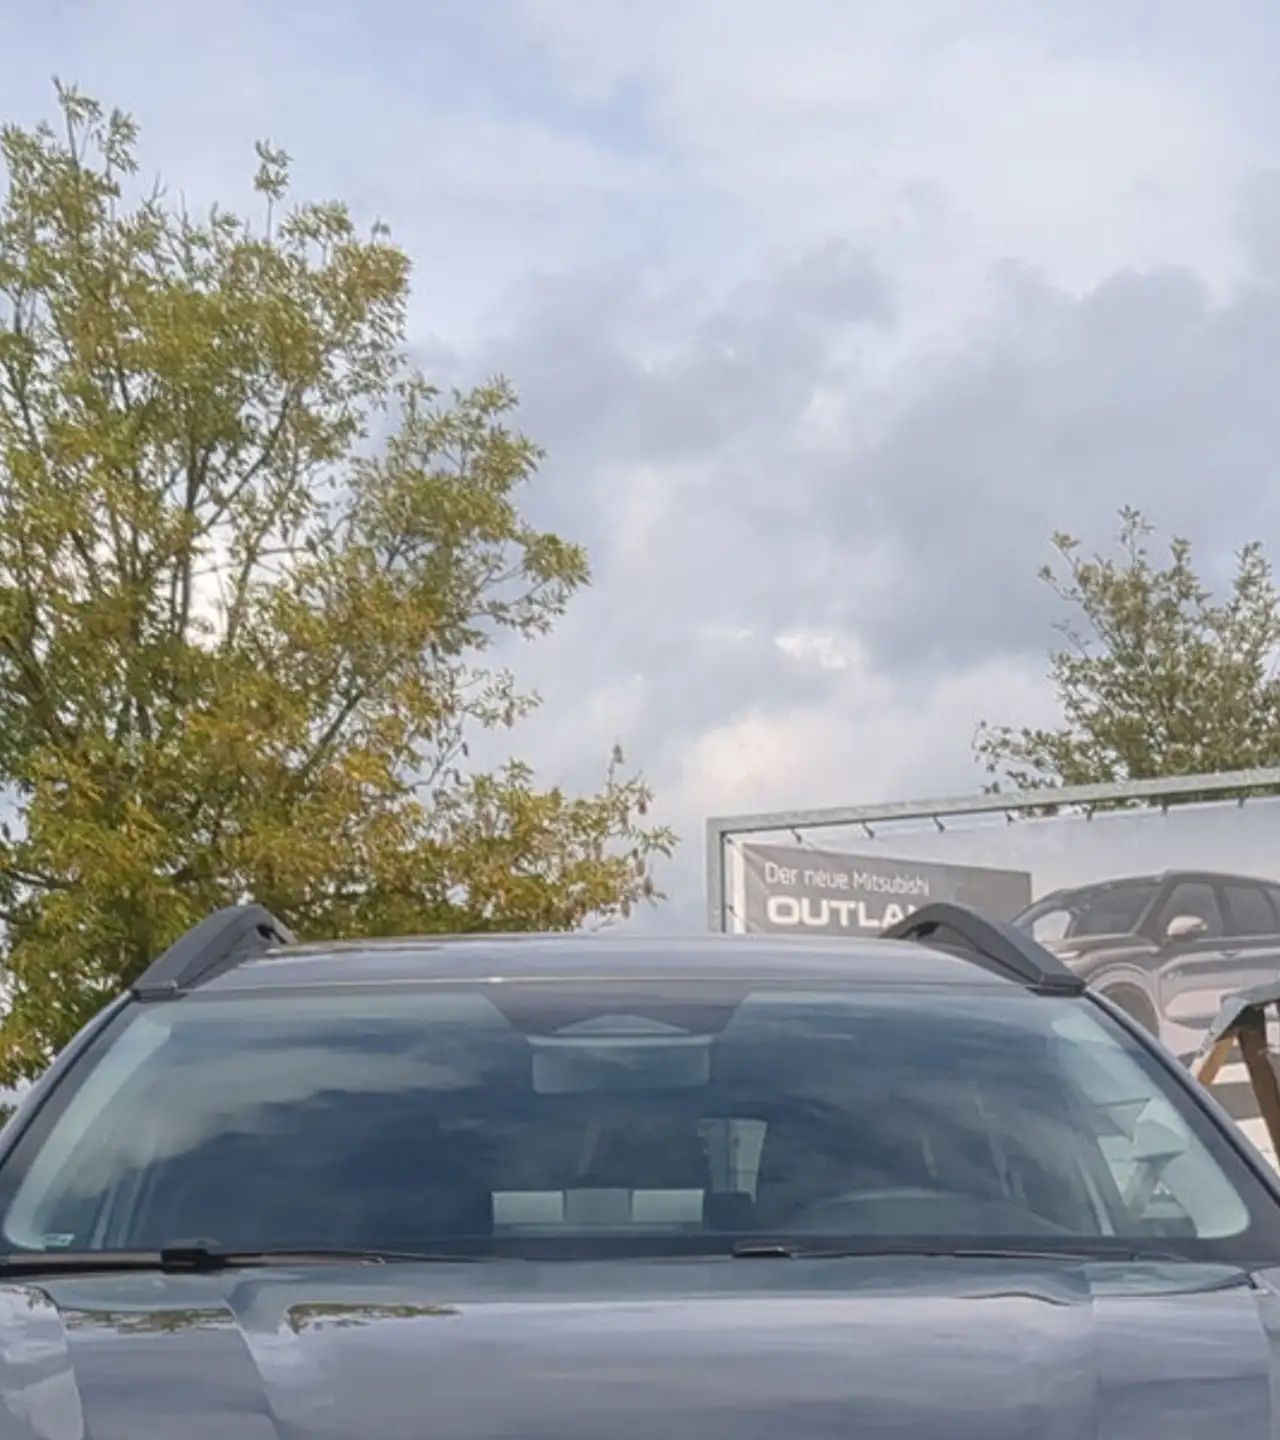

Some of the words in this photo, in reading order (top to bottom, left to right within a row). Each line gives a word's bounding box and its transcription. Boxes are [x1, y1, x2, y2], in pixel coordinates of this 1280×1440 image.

[765, 861, 799, 885] Der
[803, 868, 850, 890] neue
[767, 895, 922, 930] OUTLA
